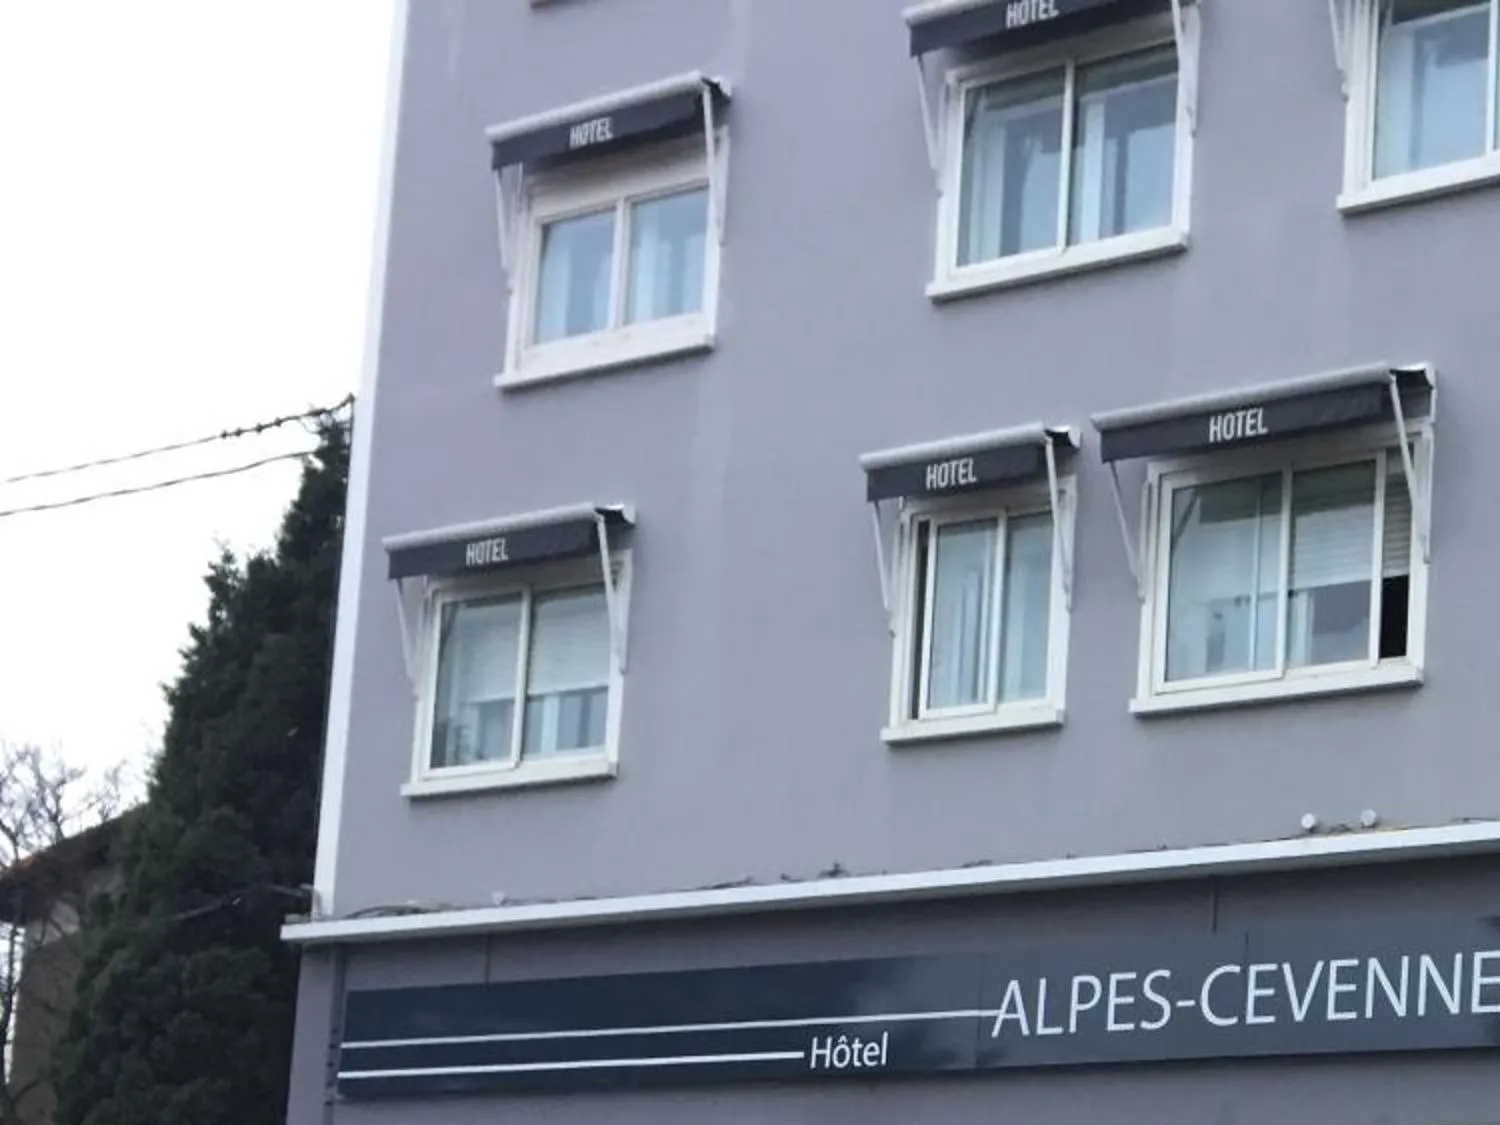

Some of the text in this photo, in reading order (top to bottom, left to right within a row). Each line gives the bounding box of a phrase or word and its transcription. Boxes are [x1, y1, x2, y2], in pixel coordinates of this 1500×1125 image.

[569, 117, 613, 146] HOTEL
[1208, 406, 1269, 441] HOTEL
[925, 457, 978, 489] HOTEL
[465, 538, 509, 566] HOTEL
[808, 1032, 889, 1070] Hôtel
